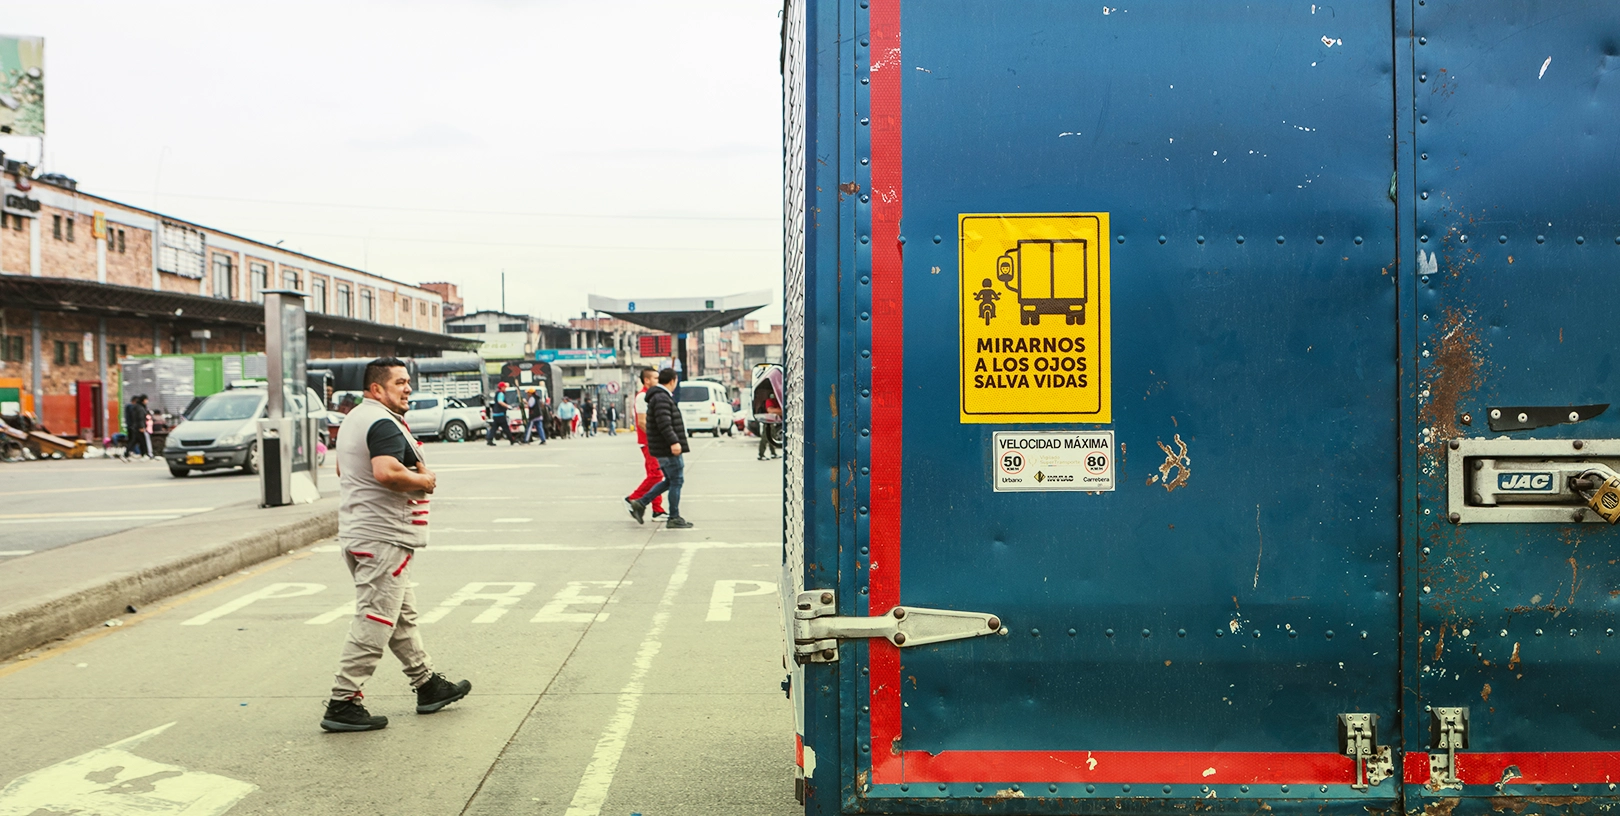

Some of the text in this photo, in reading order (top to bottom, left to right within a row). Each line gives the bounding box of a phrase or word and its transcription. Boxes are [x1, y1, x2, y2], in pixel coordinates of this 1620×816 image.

[628, 301, 636, 312] 8
[976, 337, 1086, 353] MIRARNOS
[974, 357, 1087, 372] A LOS OJOS
[974, 374, 1088, 389] SALVA VIDAS
[999, 436, 1109, 449] VELOCIDAD MÁXIMA
[1003, 456, 1022, 467] 50
[1087, 456, 1106, 467] 80
[1501, 474, 1550, 489] JAC
